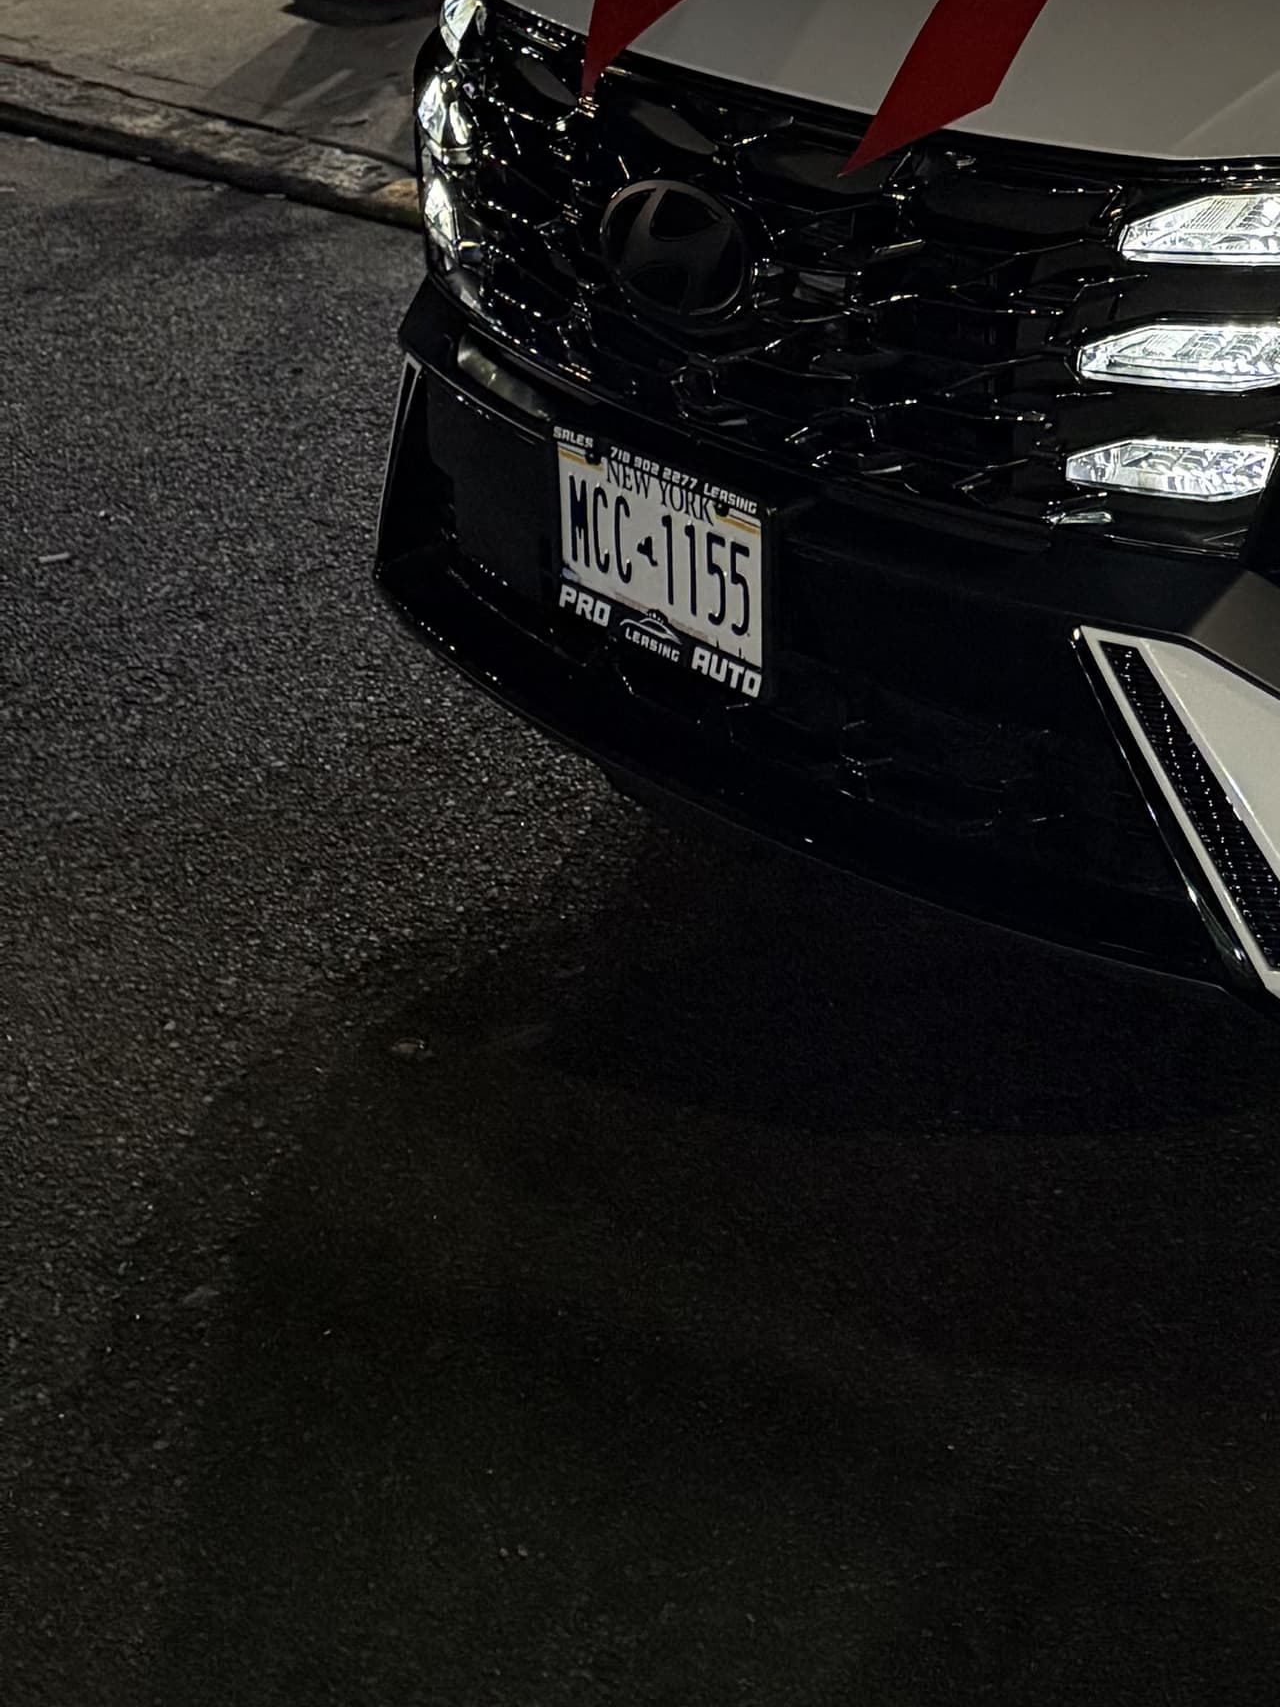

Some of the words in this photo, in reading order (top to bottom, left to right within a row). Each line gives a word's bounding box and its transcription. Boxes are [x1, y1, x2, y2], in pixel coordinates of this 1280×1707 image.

[553, 425, 594, 448] SALES
[610, 445, 631, 464] 718
[662, 467, 699, 490] 2277
[703, 482, 758, 515] LEASING
[605, 458, 652, 499] NEW
[658, 479, 715, 527] YORK
[558, 583, 612, 628] PRO
[625, 627, 681, 663] LEASING
[690, 645, 763, 699] AUTO
